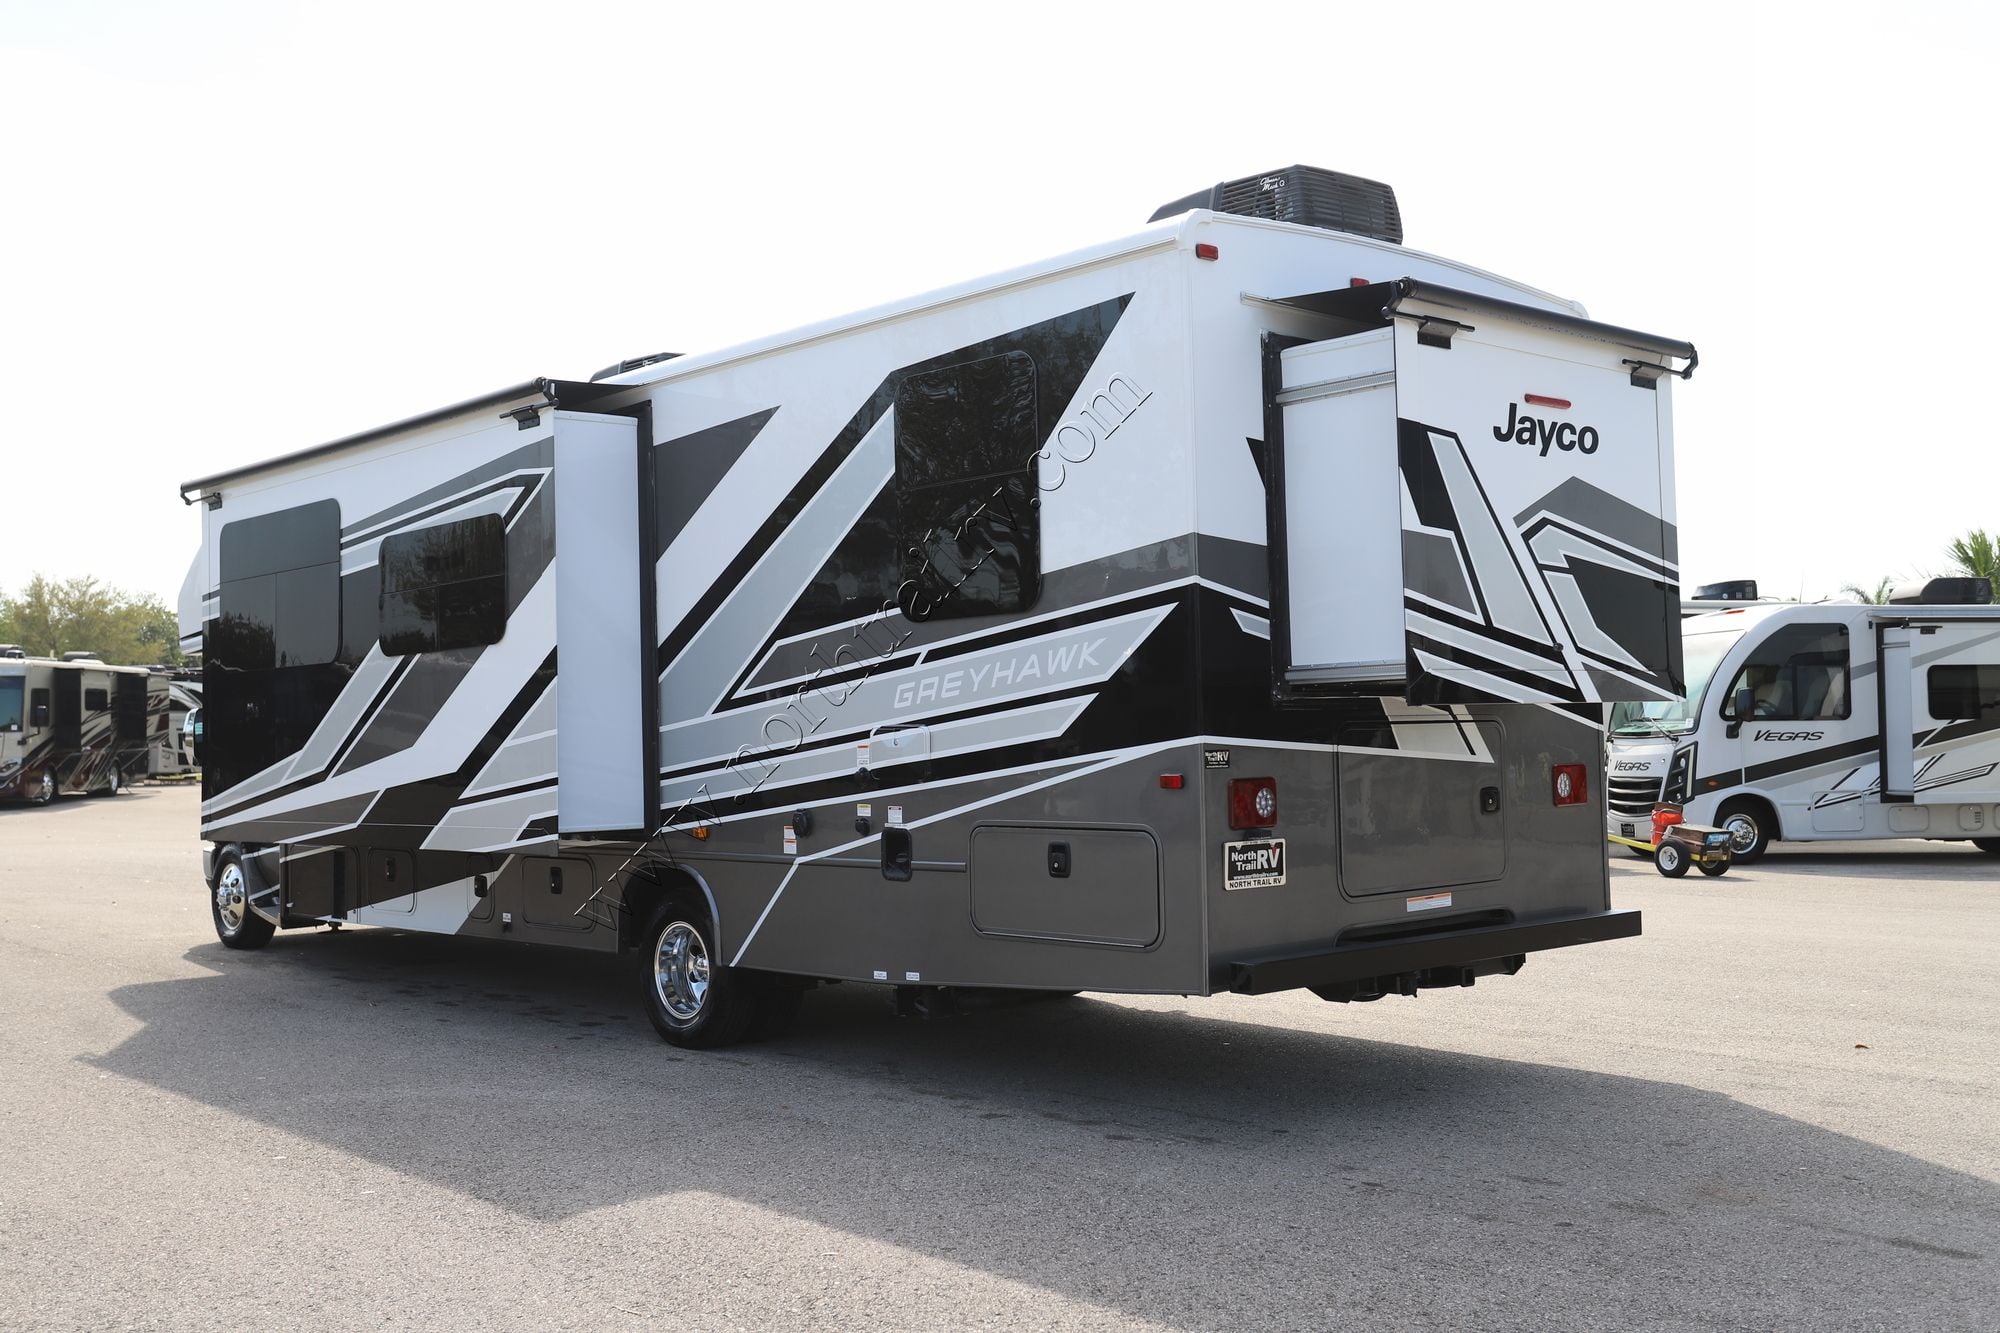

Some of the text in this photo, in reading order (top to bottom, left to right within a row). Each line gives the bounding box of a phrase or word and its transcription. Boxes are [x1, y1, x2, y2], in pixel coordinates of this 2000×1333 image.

[1493, 402, 1599, 457] Jayco
[893, 637, 1108, 709] GREYHAWK
[1754, 730, 1824, 742] VEGAS
[1615, 760, 1651, 771] VEGAS
[1231, 851, 1257, 861] North
[1257, 849, 1280, 869] RV
[1236, 861, 1257, 871] Trail
[1230, 877, 1282, 888] NORTH TRAIL RV
